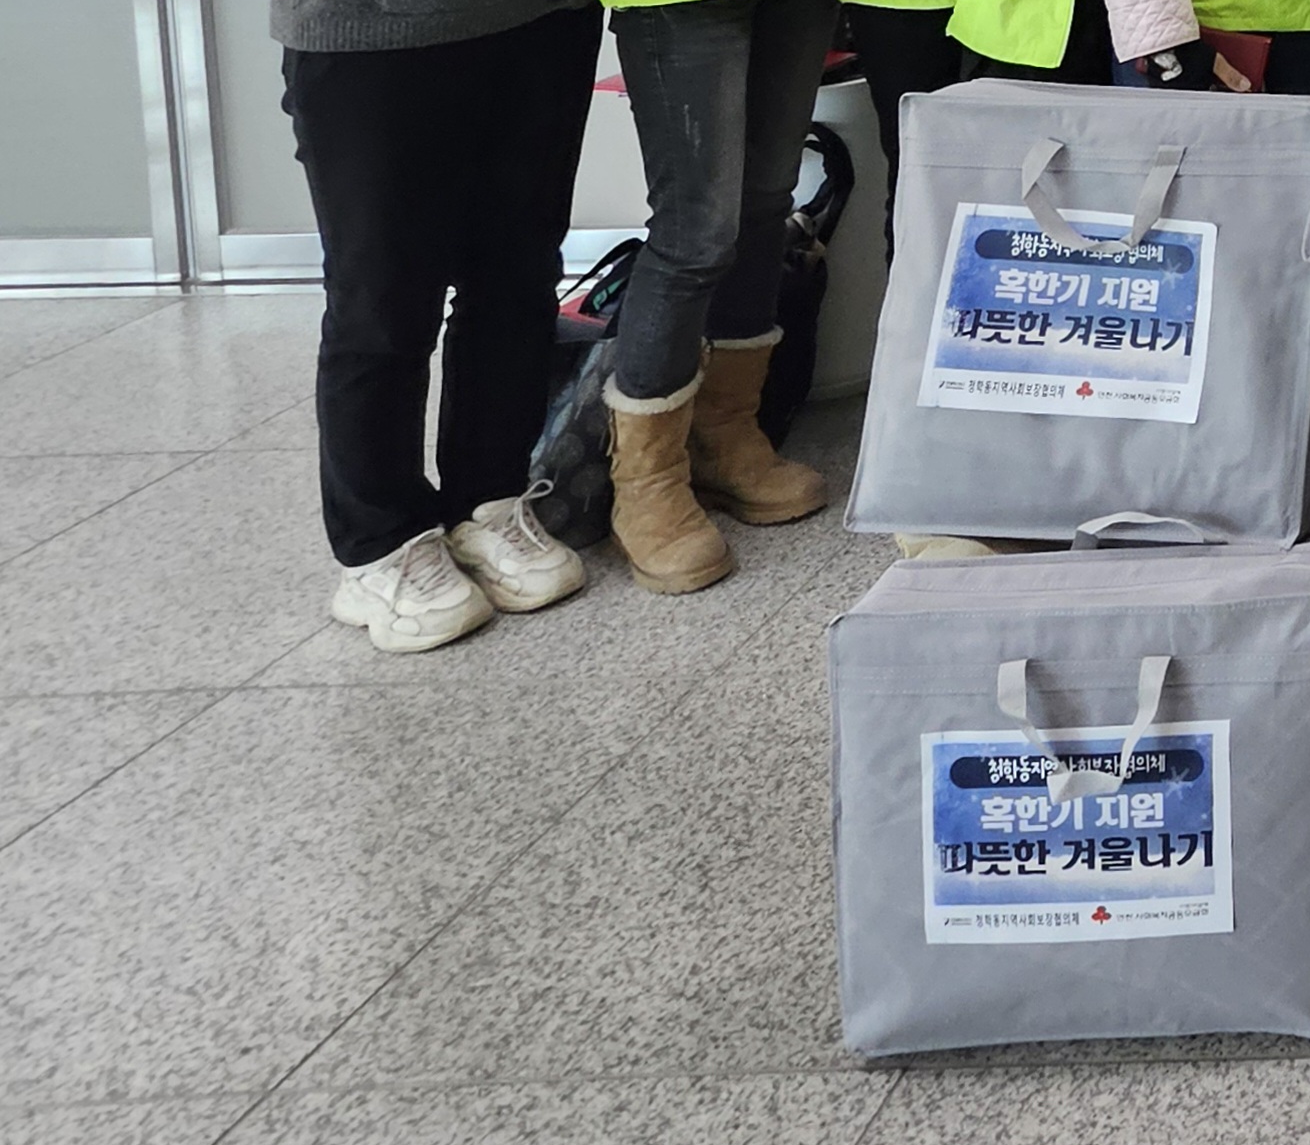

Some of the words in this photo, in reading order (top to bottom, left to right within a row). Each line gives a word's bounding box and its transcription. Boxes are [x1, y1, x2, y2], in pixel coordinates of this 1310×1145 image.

[995, 267, 1091, 307] 혹한기
[1097, 276, 1160, 313] 지원
[951, 308, 1052, 346] 따뜻한
[1059, 315, 1195, 357] 겨울나기
[980, 795, 1083, 834] 혹한기
[1095, 792, 1165, 829] 지원
[938, 838, 1051, 876] 따뜻한
[1061, 829, 1214, 872] 겨울나기
